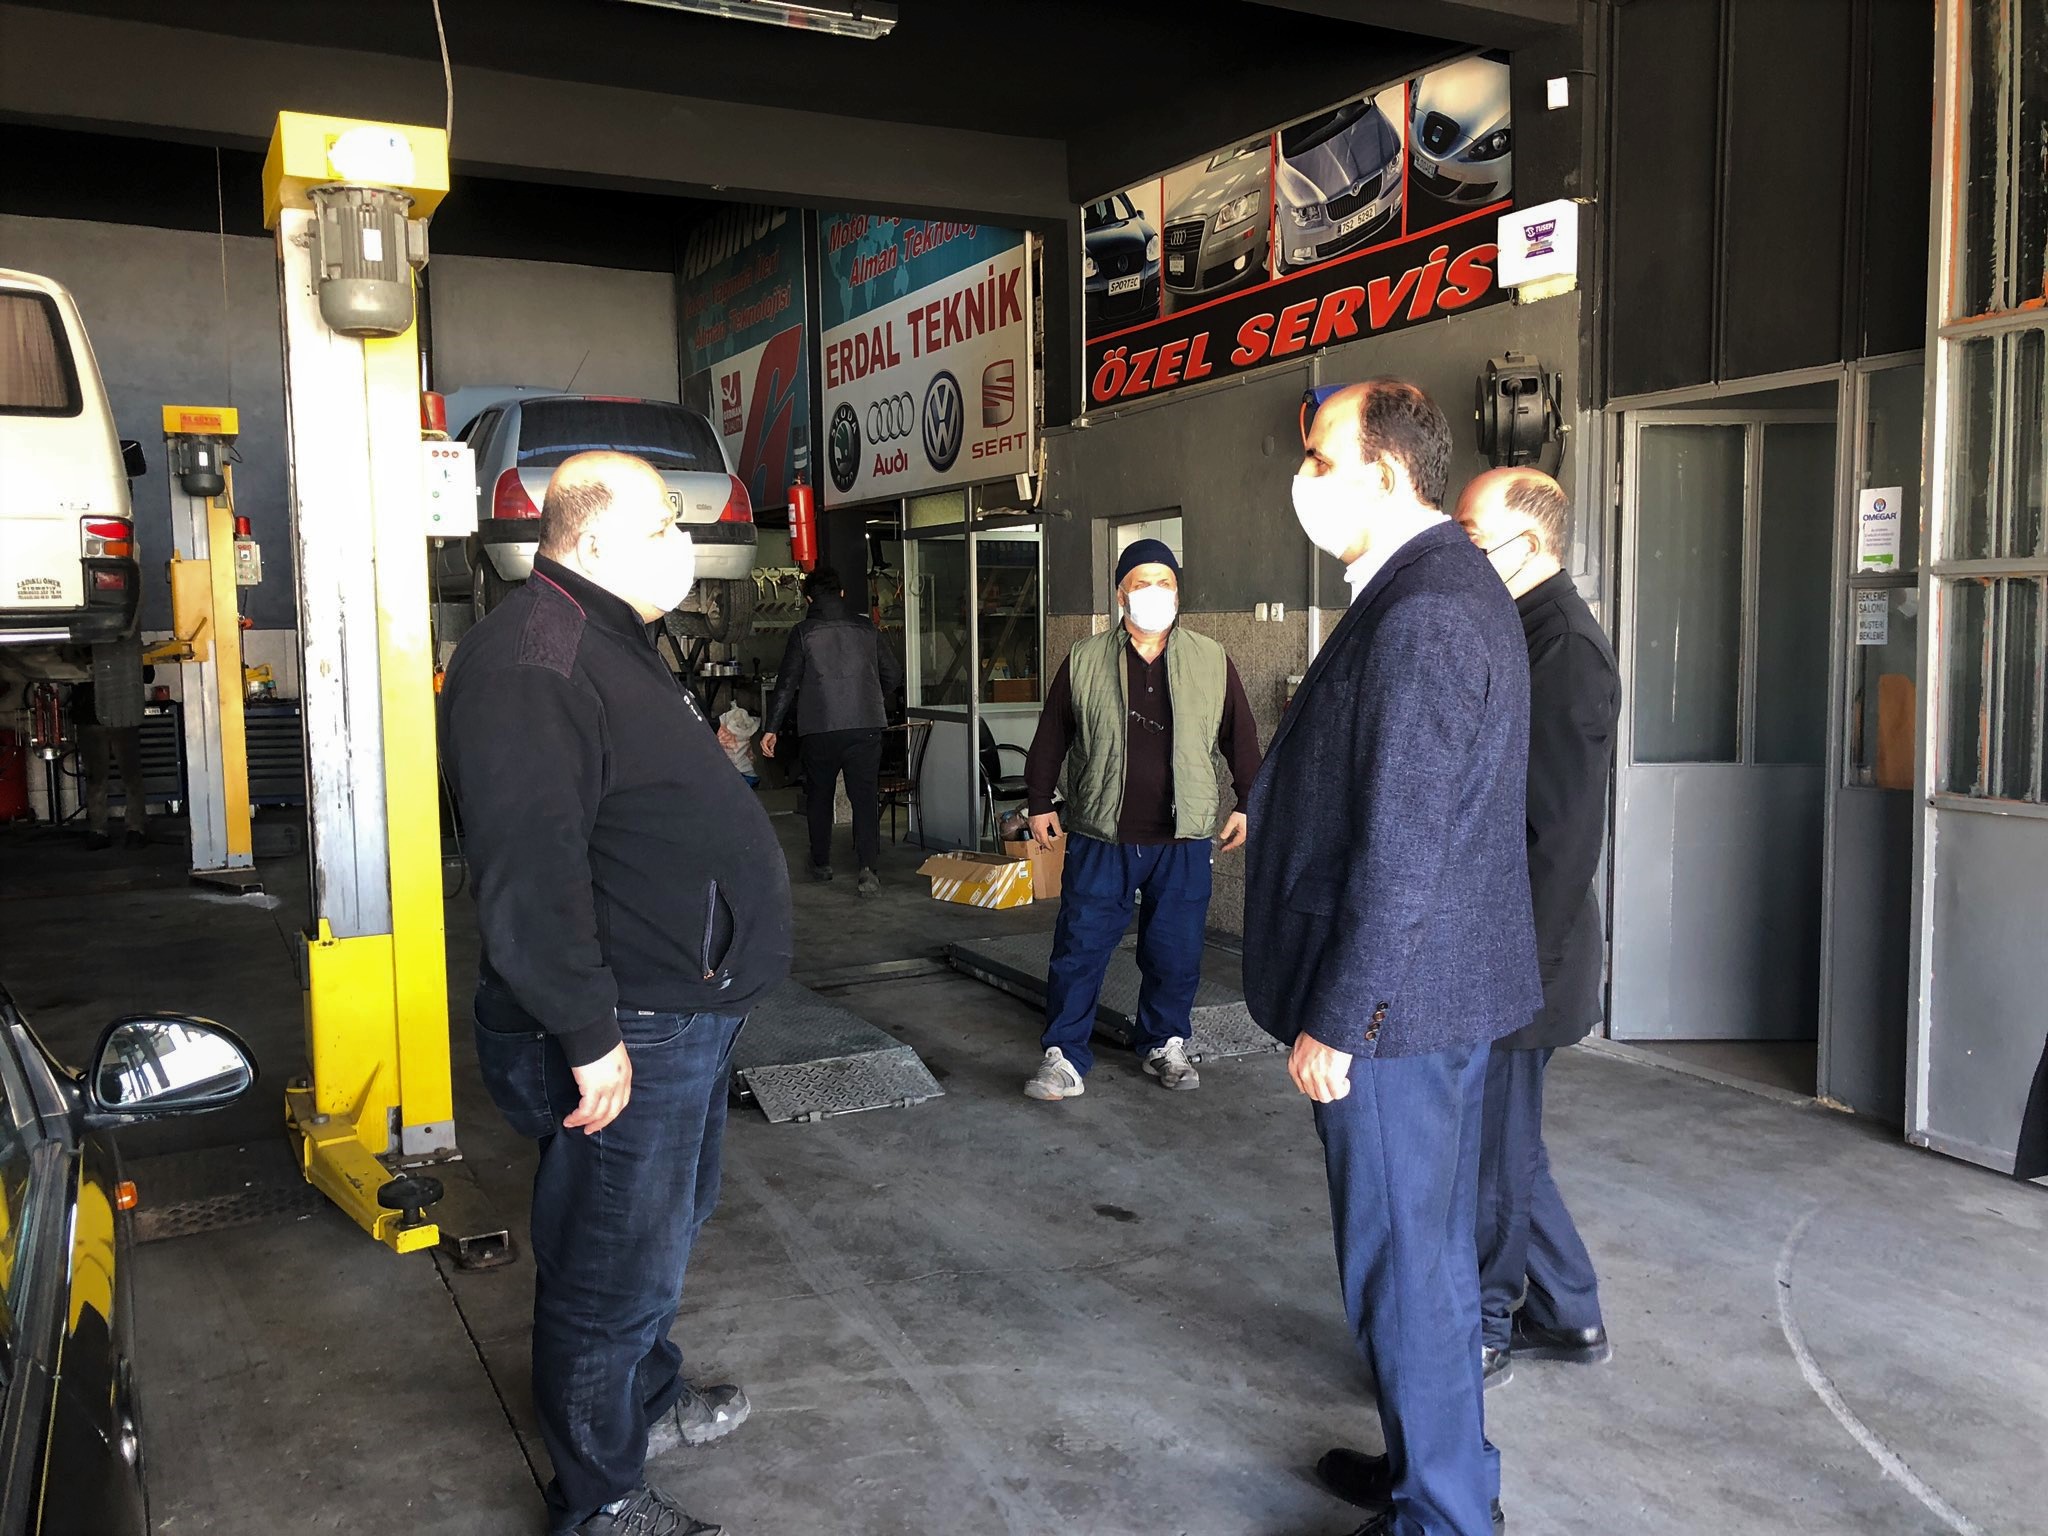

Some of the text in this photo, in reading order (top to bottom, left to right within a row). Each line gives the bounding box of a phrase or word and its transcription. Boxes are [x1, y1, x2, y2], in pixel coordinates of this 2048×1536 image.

[828, 214, 870, 256] Motor
[848, 243, 899, 289] Alman
[1110, 276, 1139, 293] SPORTEC
[826, 264, 1023, 390] ERDAL TEKNİK
[1092, 243, 1499, 403] ÖZEL SERVİS
[971, 432, 1027, 460] SEAT
[873, 448, 908, 478] Audi
[1858, 591, 1887, 601] BEKLEME
[1858, 603, 1886, 613] SALONU
[1859, 631, 1885, 640] BEKLEME
